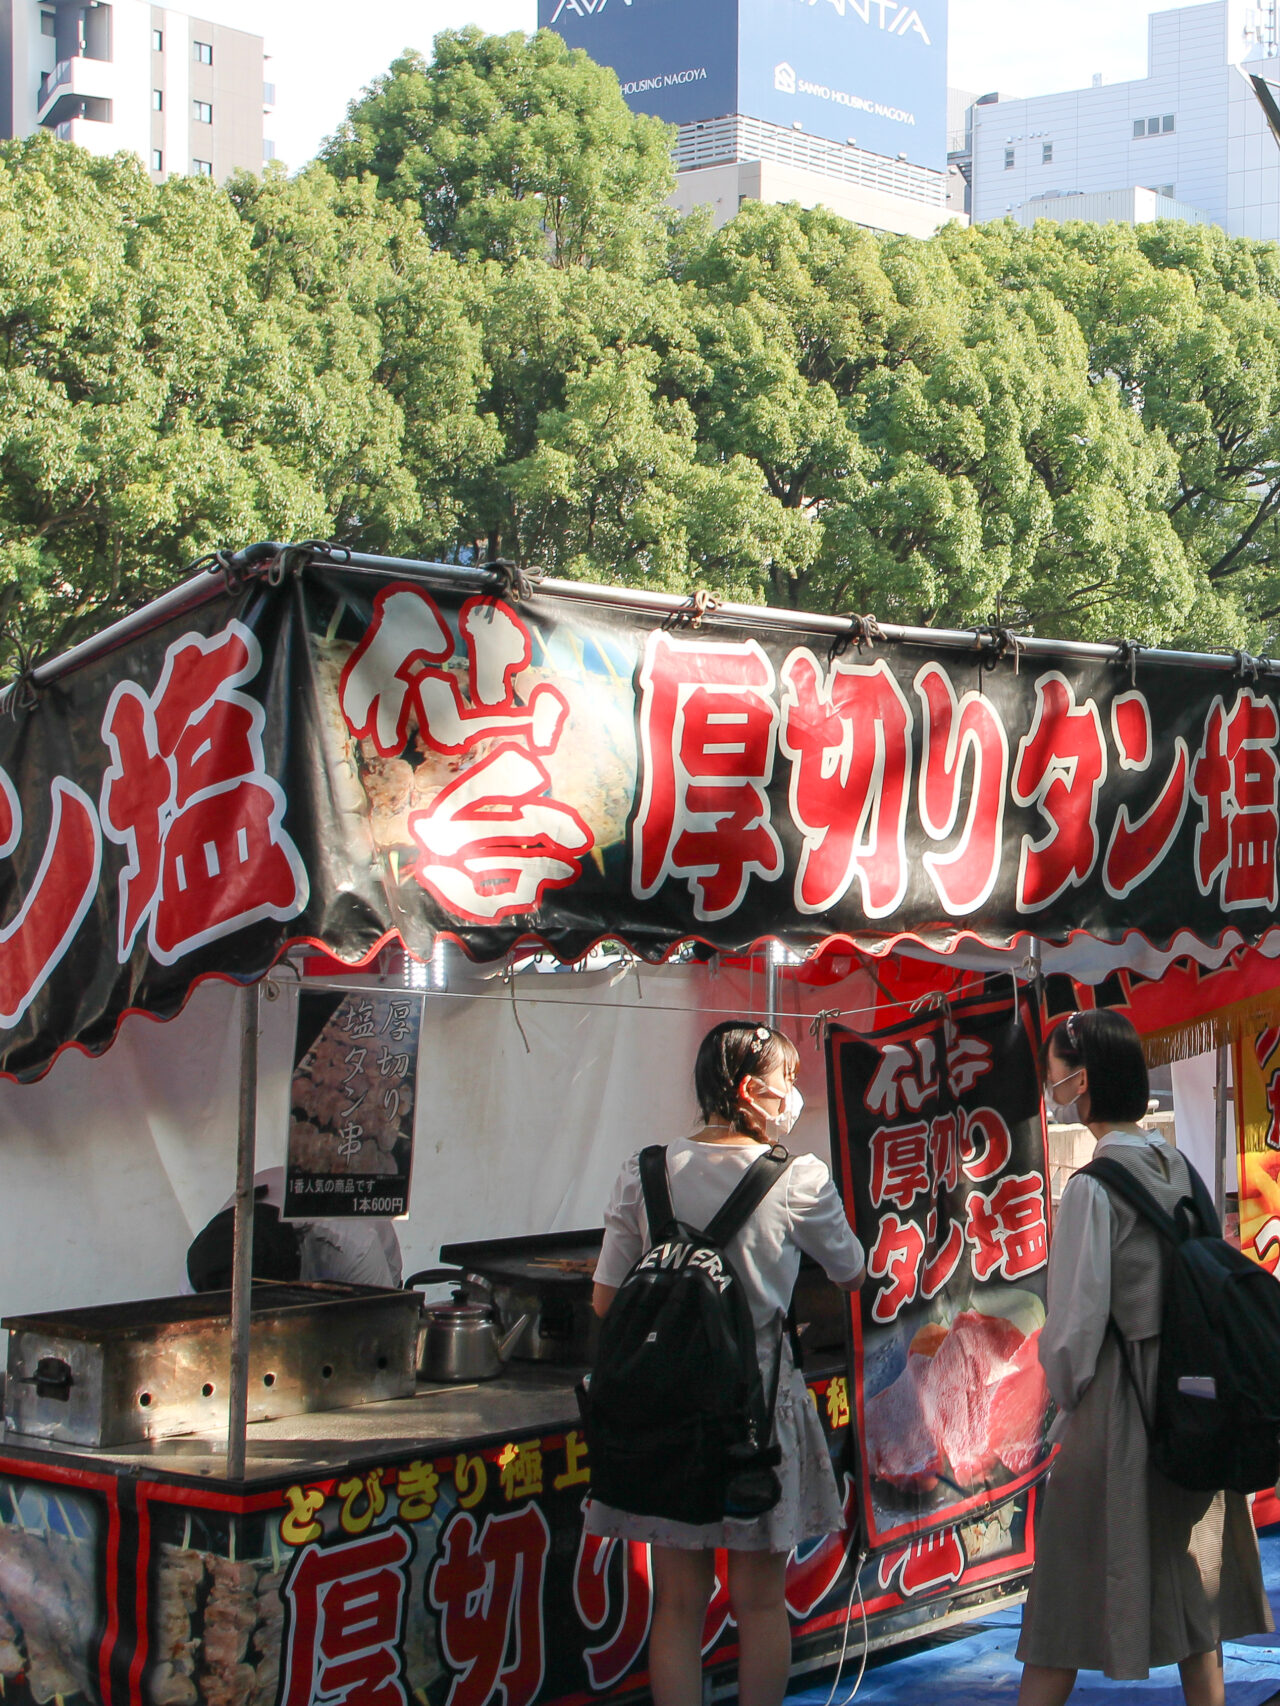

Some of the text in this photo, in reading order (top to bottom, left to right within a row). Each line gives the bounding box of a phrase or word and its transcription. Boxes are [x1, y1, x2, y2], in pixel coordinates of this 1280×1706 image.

[620, 68, 707, 95] HOUSING NAGOYA
[798, 80, 916, 126] SANYO HOUSING NAGOYA
[339, 582, 594, 925] 仙台
[632, 631, 1279, 921] 厚切りタン塩
[337, 1000, 376, 1166] 塩タン串
[376, 1000, 413, 1122] 厚切り
[867, 1035, 994, 1118] 仙台
[289, 1179, 376, 1194] 1番人気の商品です
[352, 1197, 404, 1212] 1本600円
[869, 1106, 1012, 1210] 厚切り
[635, 1243, 694, 1272] EW
[867, 1171, 1048, 1324] タン塩
[280, 1430, 591, 1545] とびきり極上
